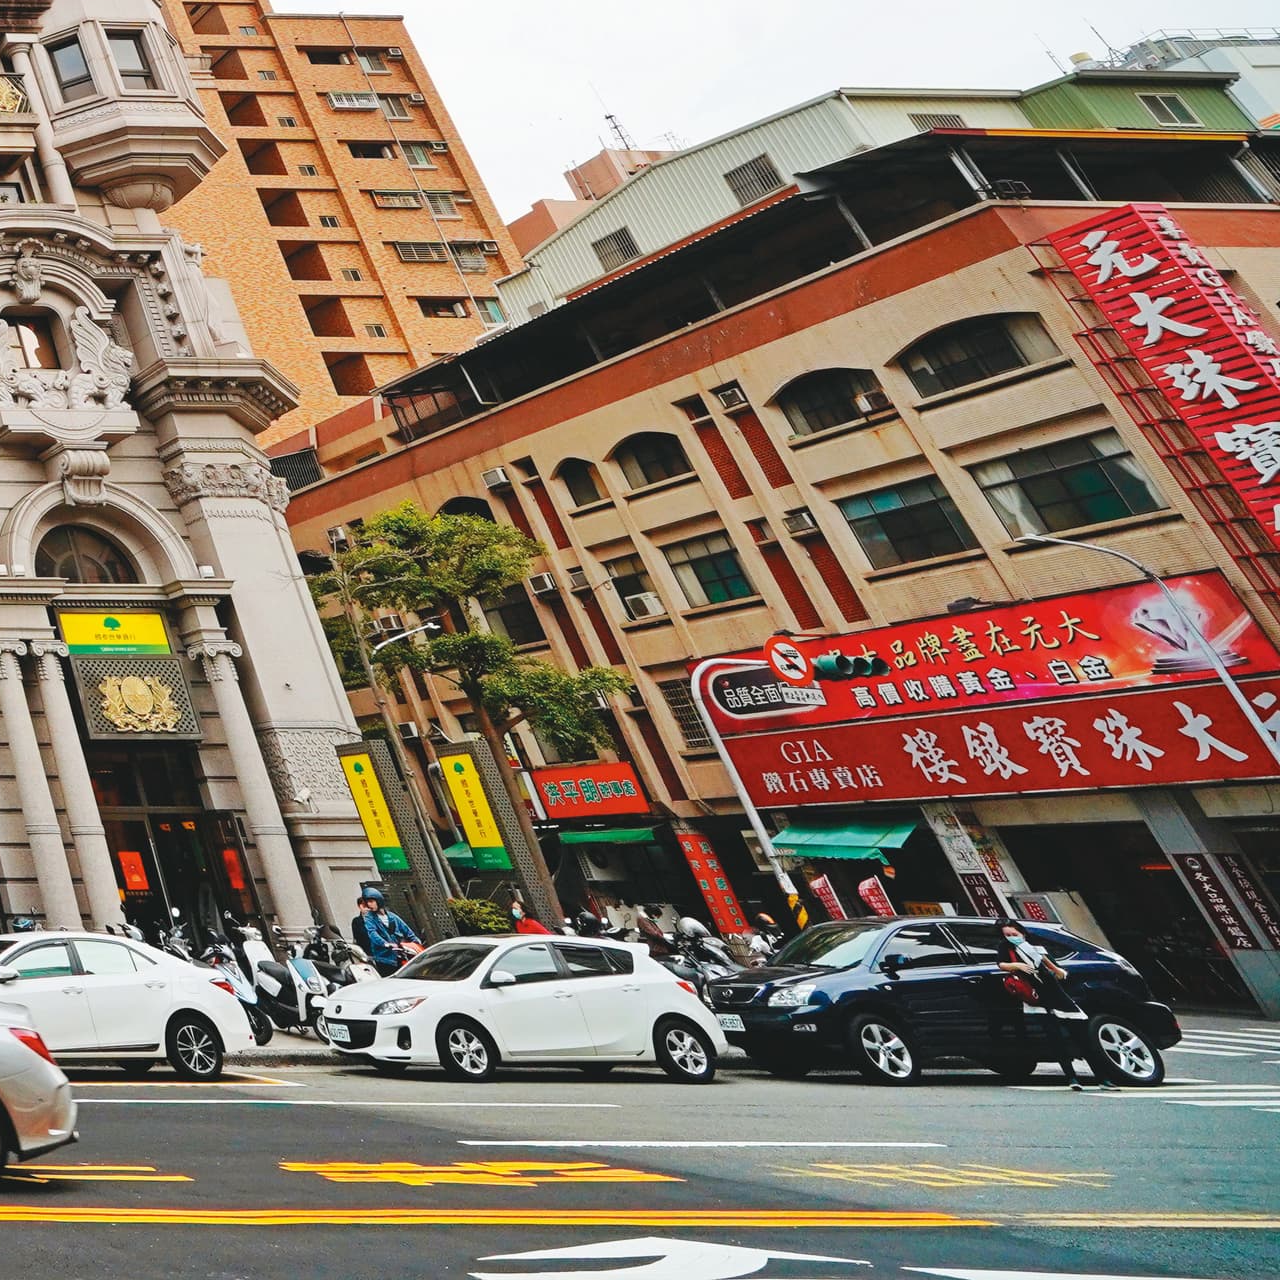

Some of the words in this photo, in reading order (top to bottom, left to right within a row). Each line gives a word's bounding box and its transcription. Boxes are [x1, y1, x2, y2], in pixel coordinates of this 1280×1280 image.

[1080, 230, 1280, 532] 元大珠寶
[723, 682, 789, 708] 品質全面
[781, 740, 834, 765] GIA
[763, 763, 883, 794] 鑽石專賣店
